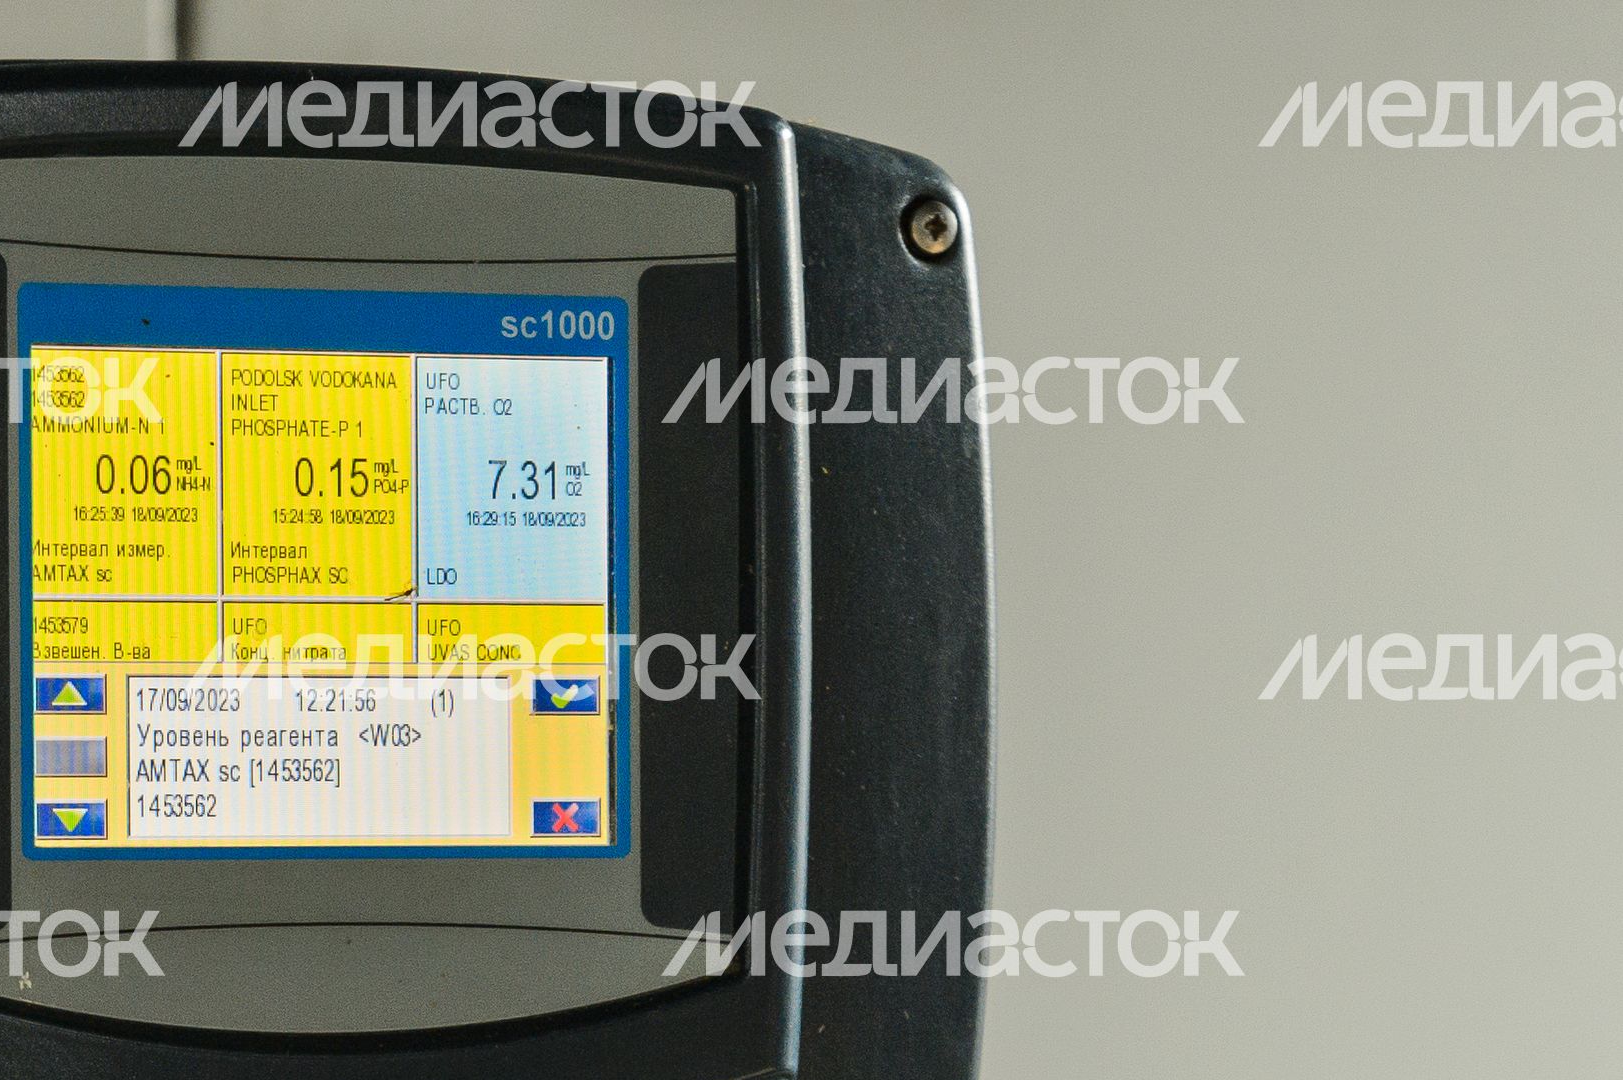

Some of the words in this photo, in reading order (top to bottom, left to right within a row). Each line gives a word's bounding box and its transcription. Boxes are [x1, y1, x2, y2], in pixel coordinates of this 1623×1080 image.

[501, 310, 615, 341] sc1000
[231, 369, 303, 387] PODOLSK
[310, 370, 397, 389] VODOKANA
[426, 372, 460, 390] UFO
[231, 394, 278, 411] INLET
[32, 415, 149, 434] AMMONIUM-N
[231, 418, 349, 437] PHOSPHATE-P
[355, 420, 363, 437] 1
[96, 454, 171, 494] 0.06
[176, 476, 211, 491] NH4-N
[295, 457, 369, 497] 0.15
[488, 459, 556, 500] 7.31
[73, 505, 125, 522] 16:25:39
[132, 506, 198, 523] 18/09/2023
[273, 508, 323, 525] 15:24:58
[330, 509, 395, 525] 18/09/2023
[466, 510, 517, 527] 16:29:15
[522, 511, 586, 527] 18/09/2023
[33, 539, 108, 561] Интервал
[230, 541, 308, 562] Интервал
[33, 564, 89, 582] AMTAX
[232, 566, 321, 584] PHOSPHAX
[427, 568, 458, 585] LDO
[34, 616, 89, 635] 1453579
[232, 618, 267, 635] UFO
[427, 619, 461, 637] UFO
[136, 687, 241, 713] 17/09/2023
[295, 688, 377, 712] 12:21:56
[431, 688, 455, 717] (1)
[137, 723, 230, 753] Уровень
[241, 728, 339, 752] реагента
[136, 758, 210, 783] AMTAX
[219, 764, 241, 782] sc
[249, 758, 341, 788] [1453562]
[137, 793, 217, 818] 1453562
